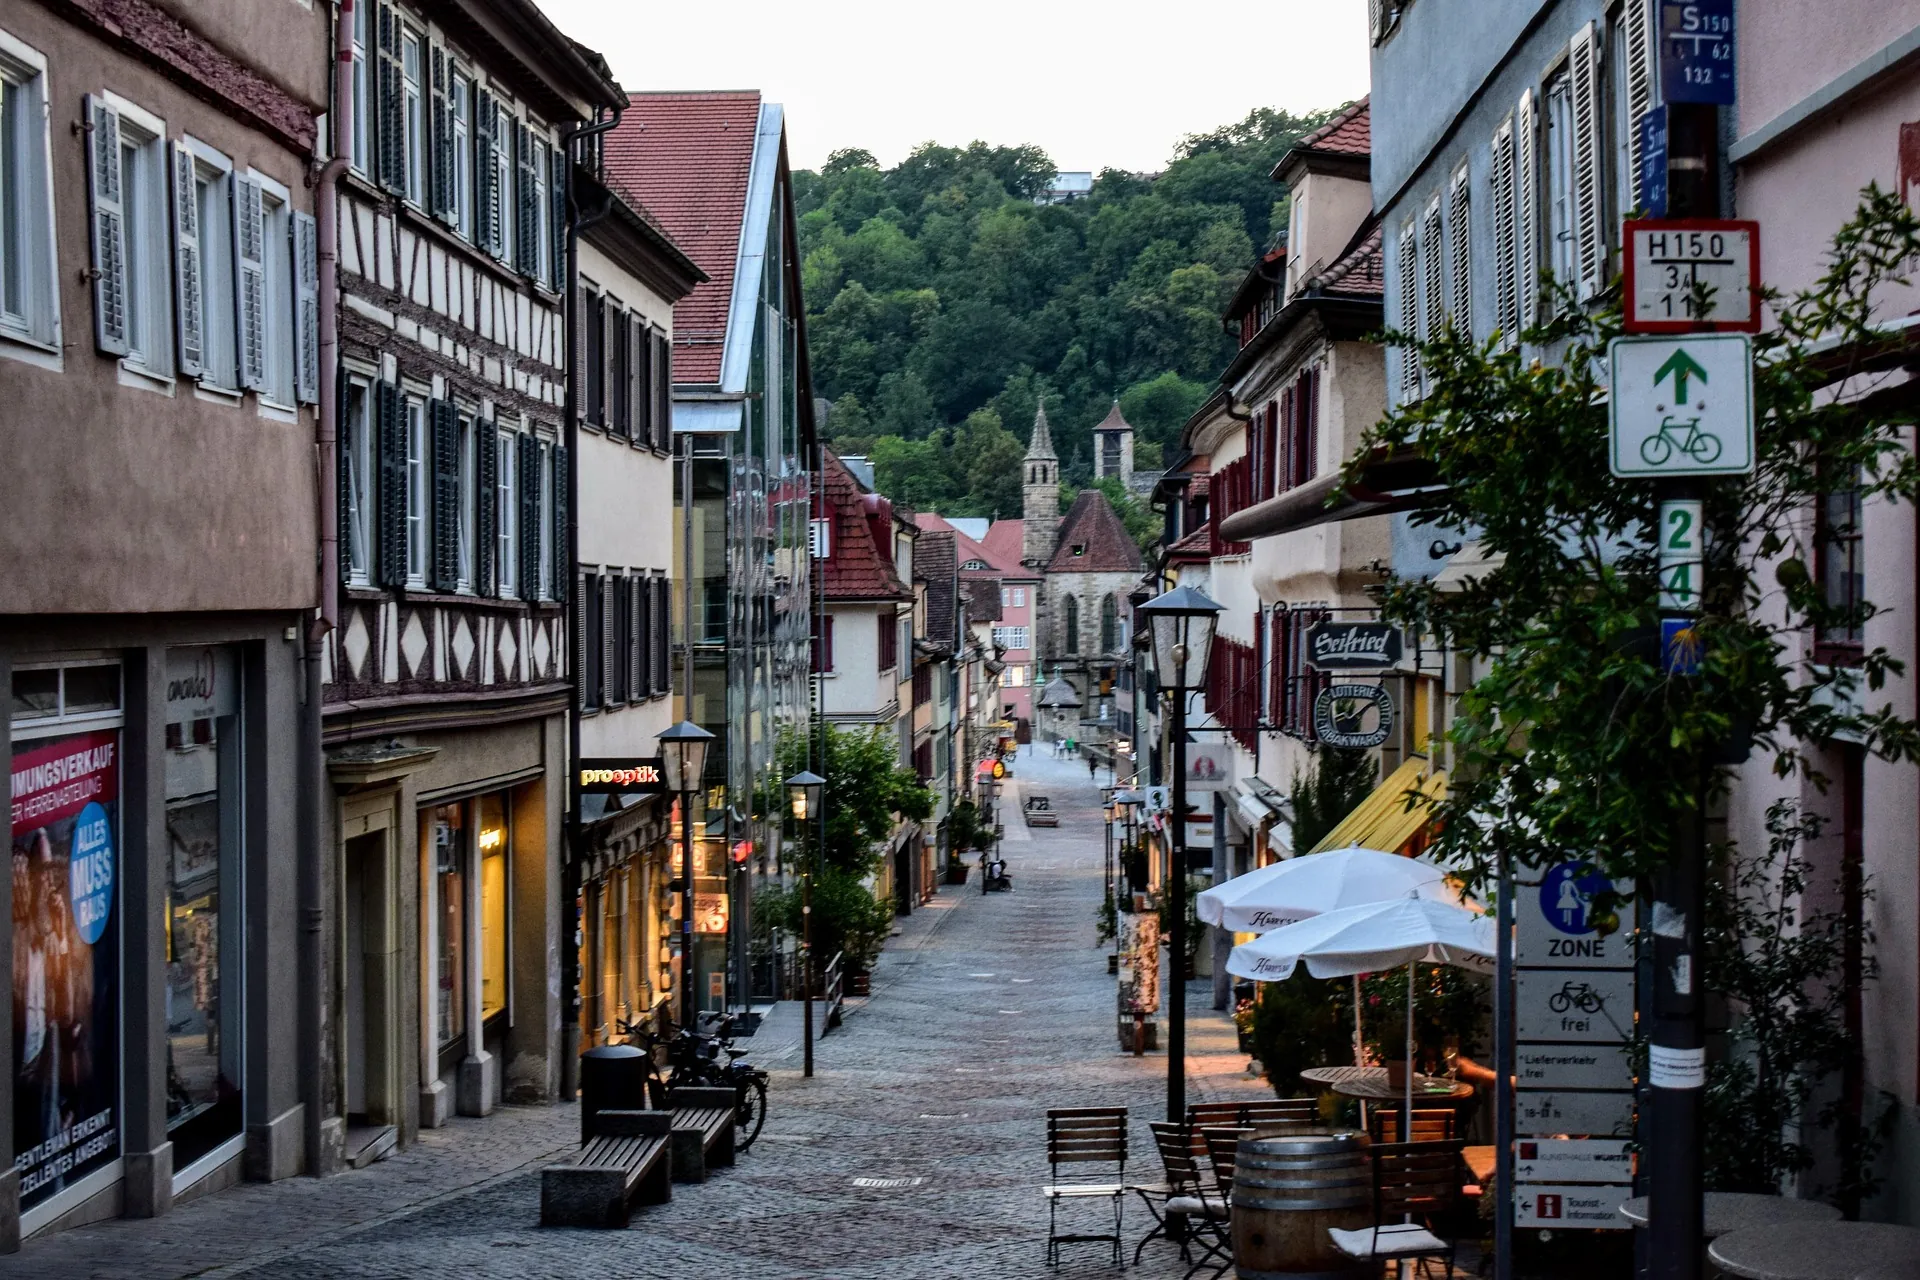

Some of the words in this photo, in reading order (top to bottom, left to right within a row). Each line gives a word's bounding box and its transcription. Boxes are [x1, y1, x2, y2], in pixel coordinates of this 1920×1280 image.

[1648, 233, 1723, 257] H150
[1667, 509, 1692, 549] 2
[1668, 563, 1692, 602] 4
[1314, 626, 1390, 660] Seifried
[1330, 685, 1376, 699] LOTTERIE
[24, 775, 102, 819] HERRENABTEILUNG
[76, 818, 106, 855] ALLES
[71, 847, 112, 901] MUSS
[1548, 939, 1605, 957] ZONE
[1561, 1016, 1590, 1032] frei
[1525, 1054, 1597, 1065] Lieferverkehr
